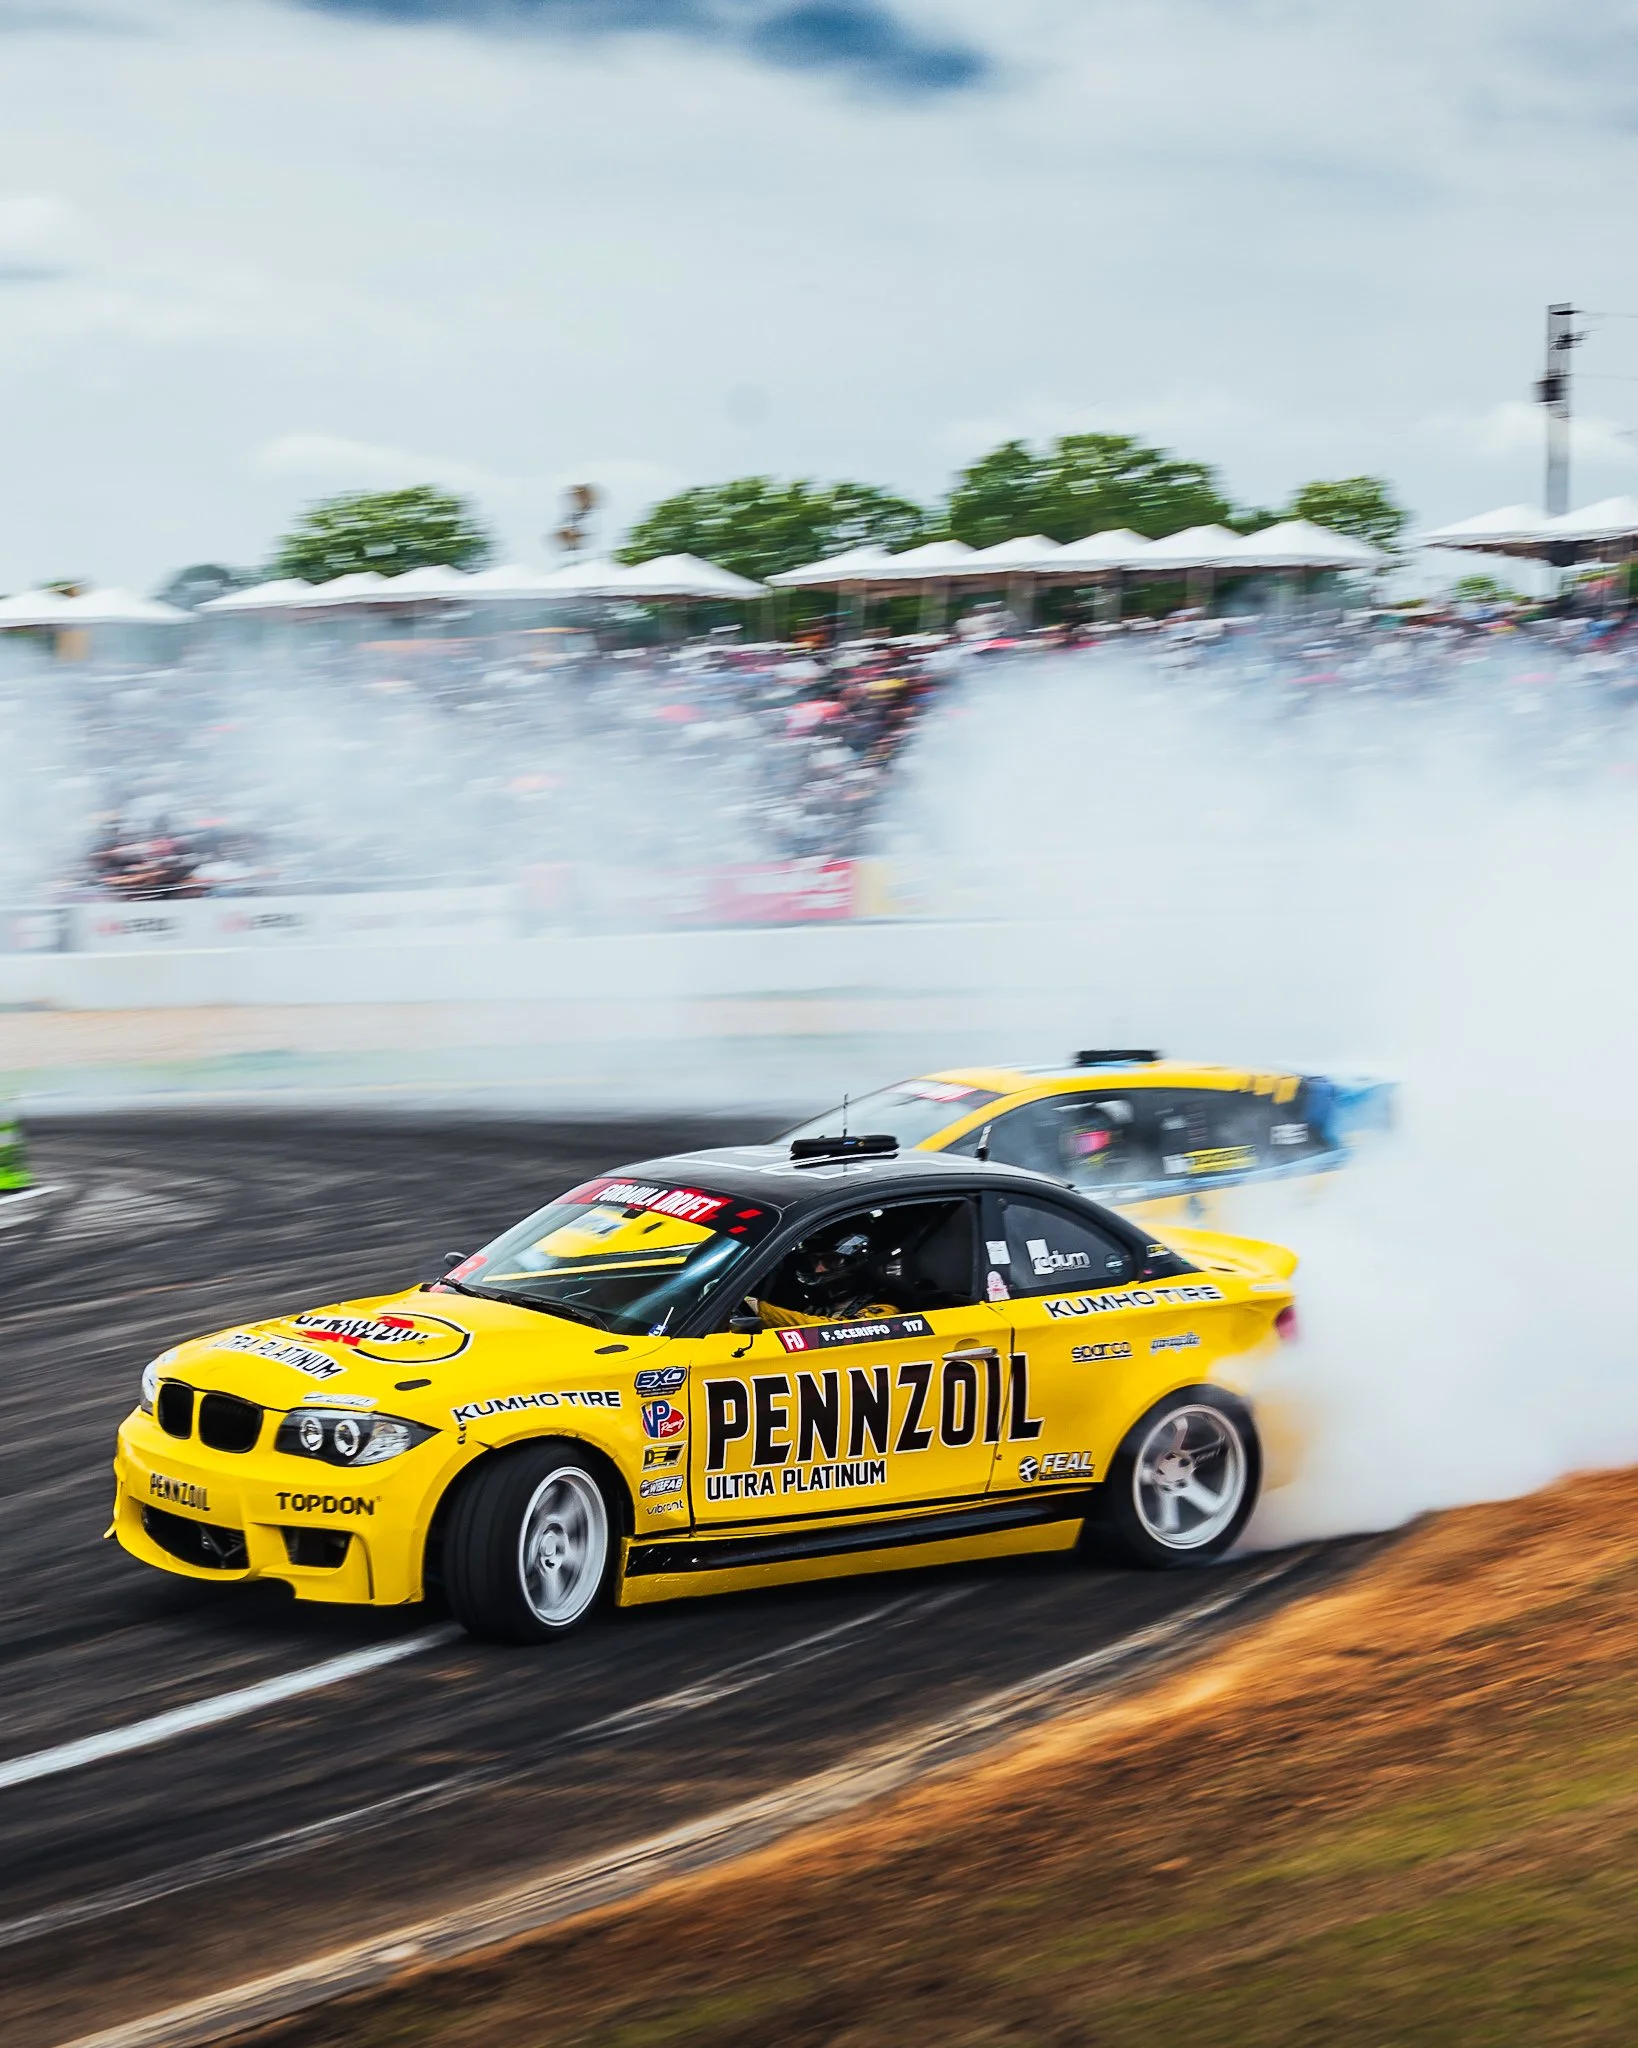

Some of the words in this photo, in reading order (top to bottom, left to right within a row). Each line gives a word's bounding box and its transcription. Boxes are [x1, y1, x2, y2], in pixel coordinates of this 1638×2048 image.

[591, 1183, 669, 1207] FORMULA
[651, 1190, 722, 1220] DRIFT
[1045, 1291, 1155, 1318] KUMHO
[1154, 1286, 1223, 1303] TIRE
[834, 1324, 891, 1340] SCERIFFO
[902, 1319, 923, 1332] 117
[782, 1331, 805, 1350] FD
[1071, 1341, 1132, 1359] sparco
[250, 1341, 343, 1379] PLATINUM
[636, 1367, 687, 1388] EXO
[453, 1393, 559, 1423] KUMHO
[560, 1391, 622, 1407] TIRE
[641, 1400, 671, 1438] VP
[703, 1353, 1045, 1472] PENNZOIL
[1040, 1451, 1095, 1474] FEAL
[150, 1472, 212, 1513] PENNZOIL
[706, 1471, 775, 1501] ULTRA
[782, 1460, 887, 1494] PLATINUM
[275, 1491, 375, 1516] TOPDON
[646, 1499, 684, 1514] vibrant
